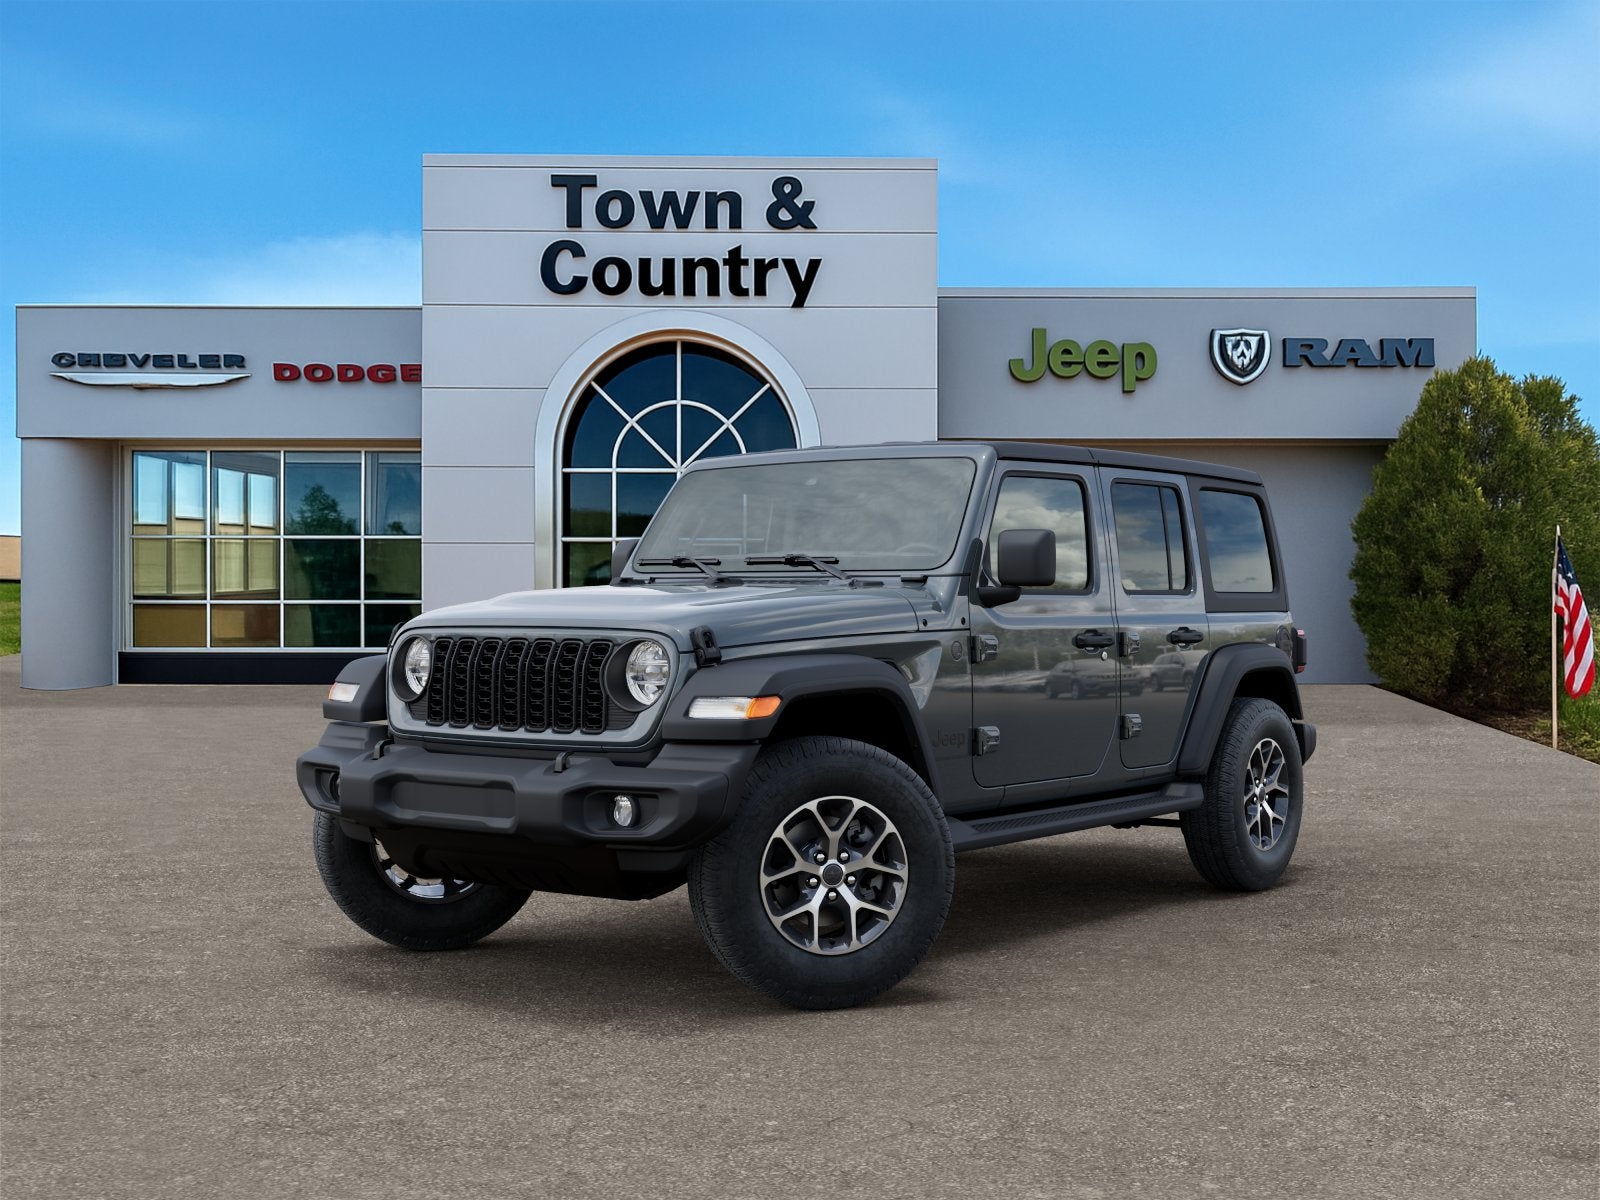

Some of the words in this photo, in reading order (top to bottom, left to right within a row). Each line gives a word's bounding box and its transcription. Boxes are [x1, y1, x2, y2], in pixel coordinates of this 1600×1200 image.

[550, 174, 742, 229] Town
[765, 176, 818, 229] &
[540, 239, 822, 308] Country
[273, 363, 422, 383] DODGE
[1009, 328, 1157, 392] Jeep
[1282, 337, 1435, 367] RAM
[932, 728, 966, 749] Jeep
